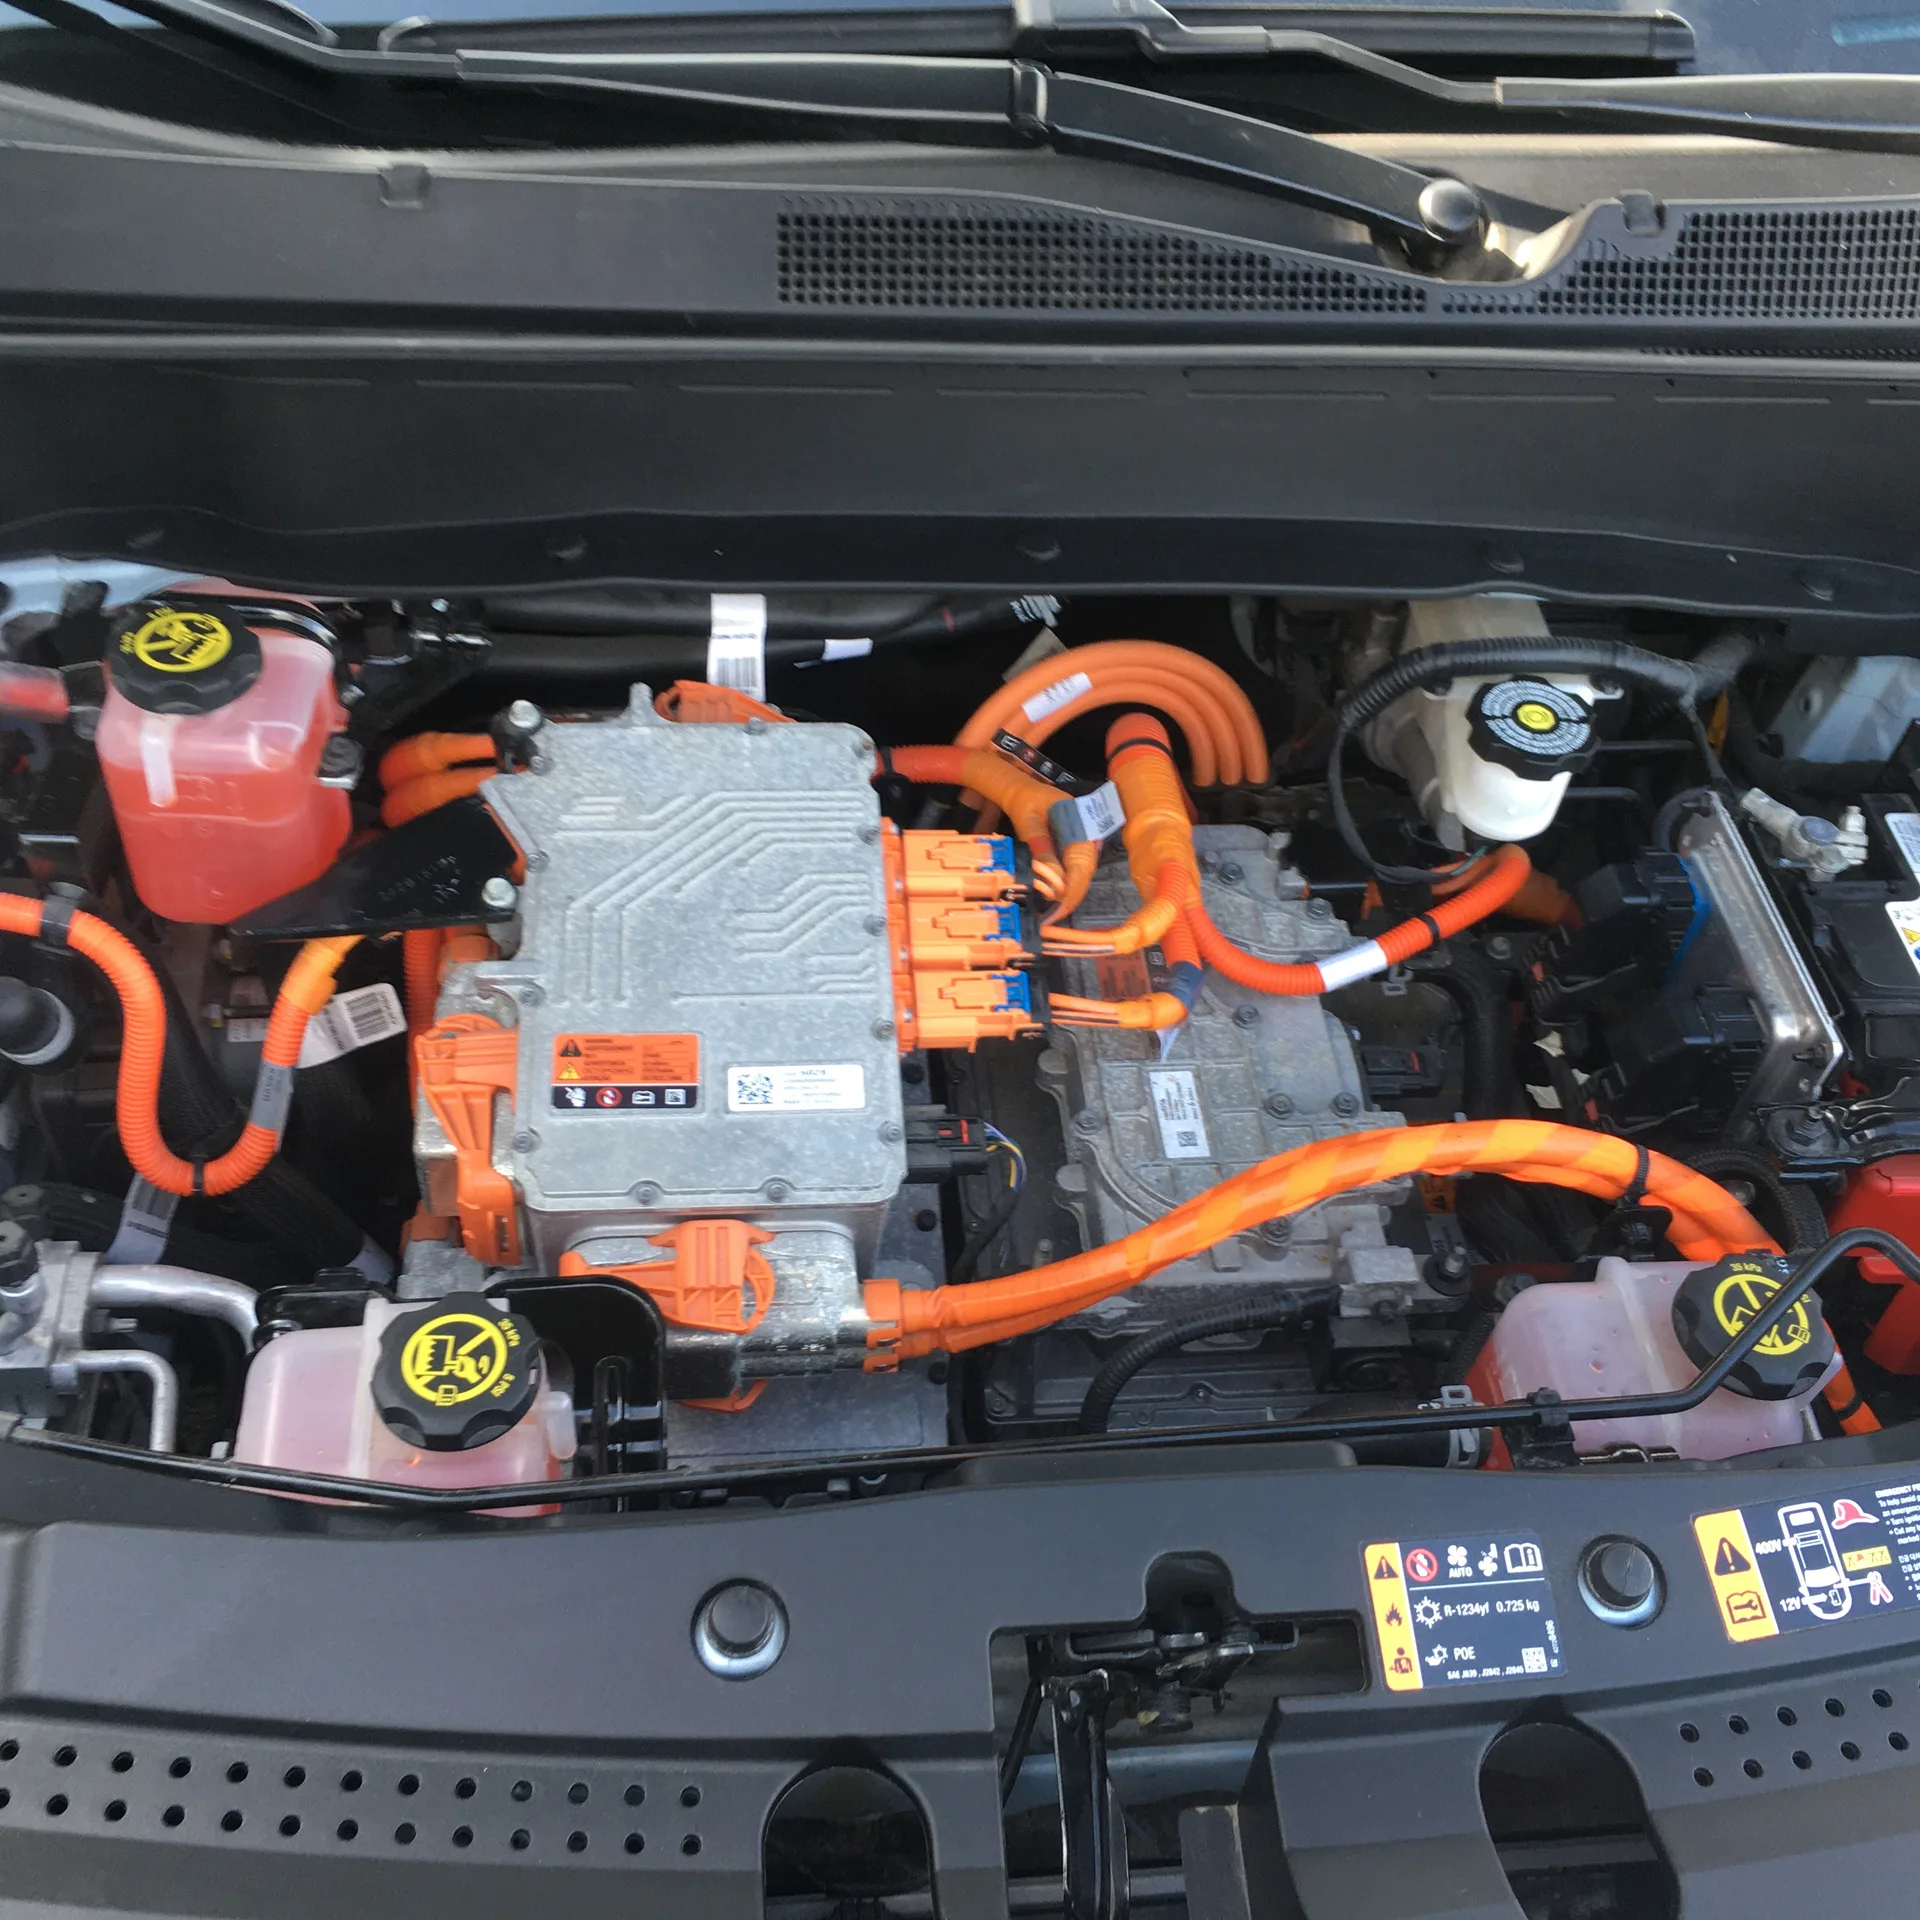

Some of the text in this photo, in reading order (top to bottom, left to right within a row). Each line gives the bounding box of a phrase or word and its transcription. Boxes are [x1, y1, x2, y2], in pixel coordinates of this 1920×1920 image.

[1886, 1498, 1900, 1506] help
[1755, 1538, 1782, 1555] 400V
[1449, 1566, 1473, 1578] AUTO
[1444, 1599, 1540, 1617] R-1234yf 0.725 kg
[1780, 1596, 1801, 1612] 12V
[1453, 1646, 1476, 1661] POE
[1447, 1670, 1461, 1680] SAE
